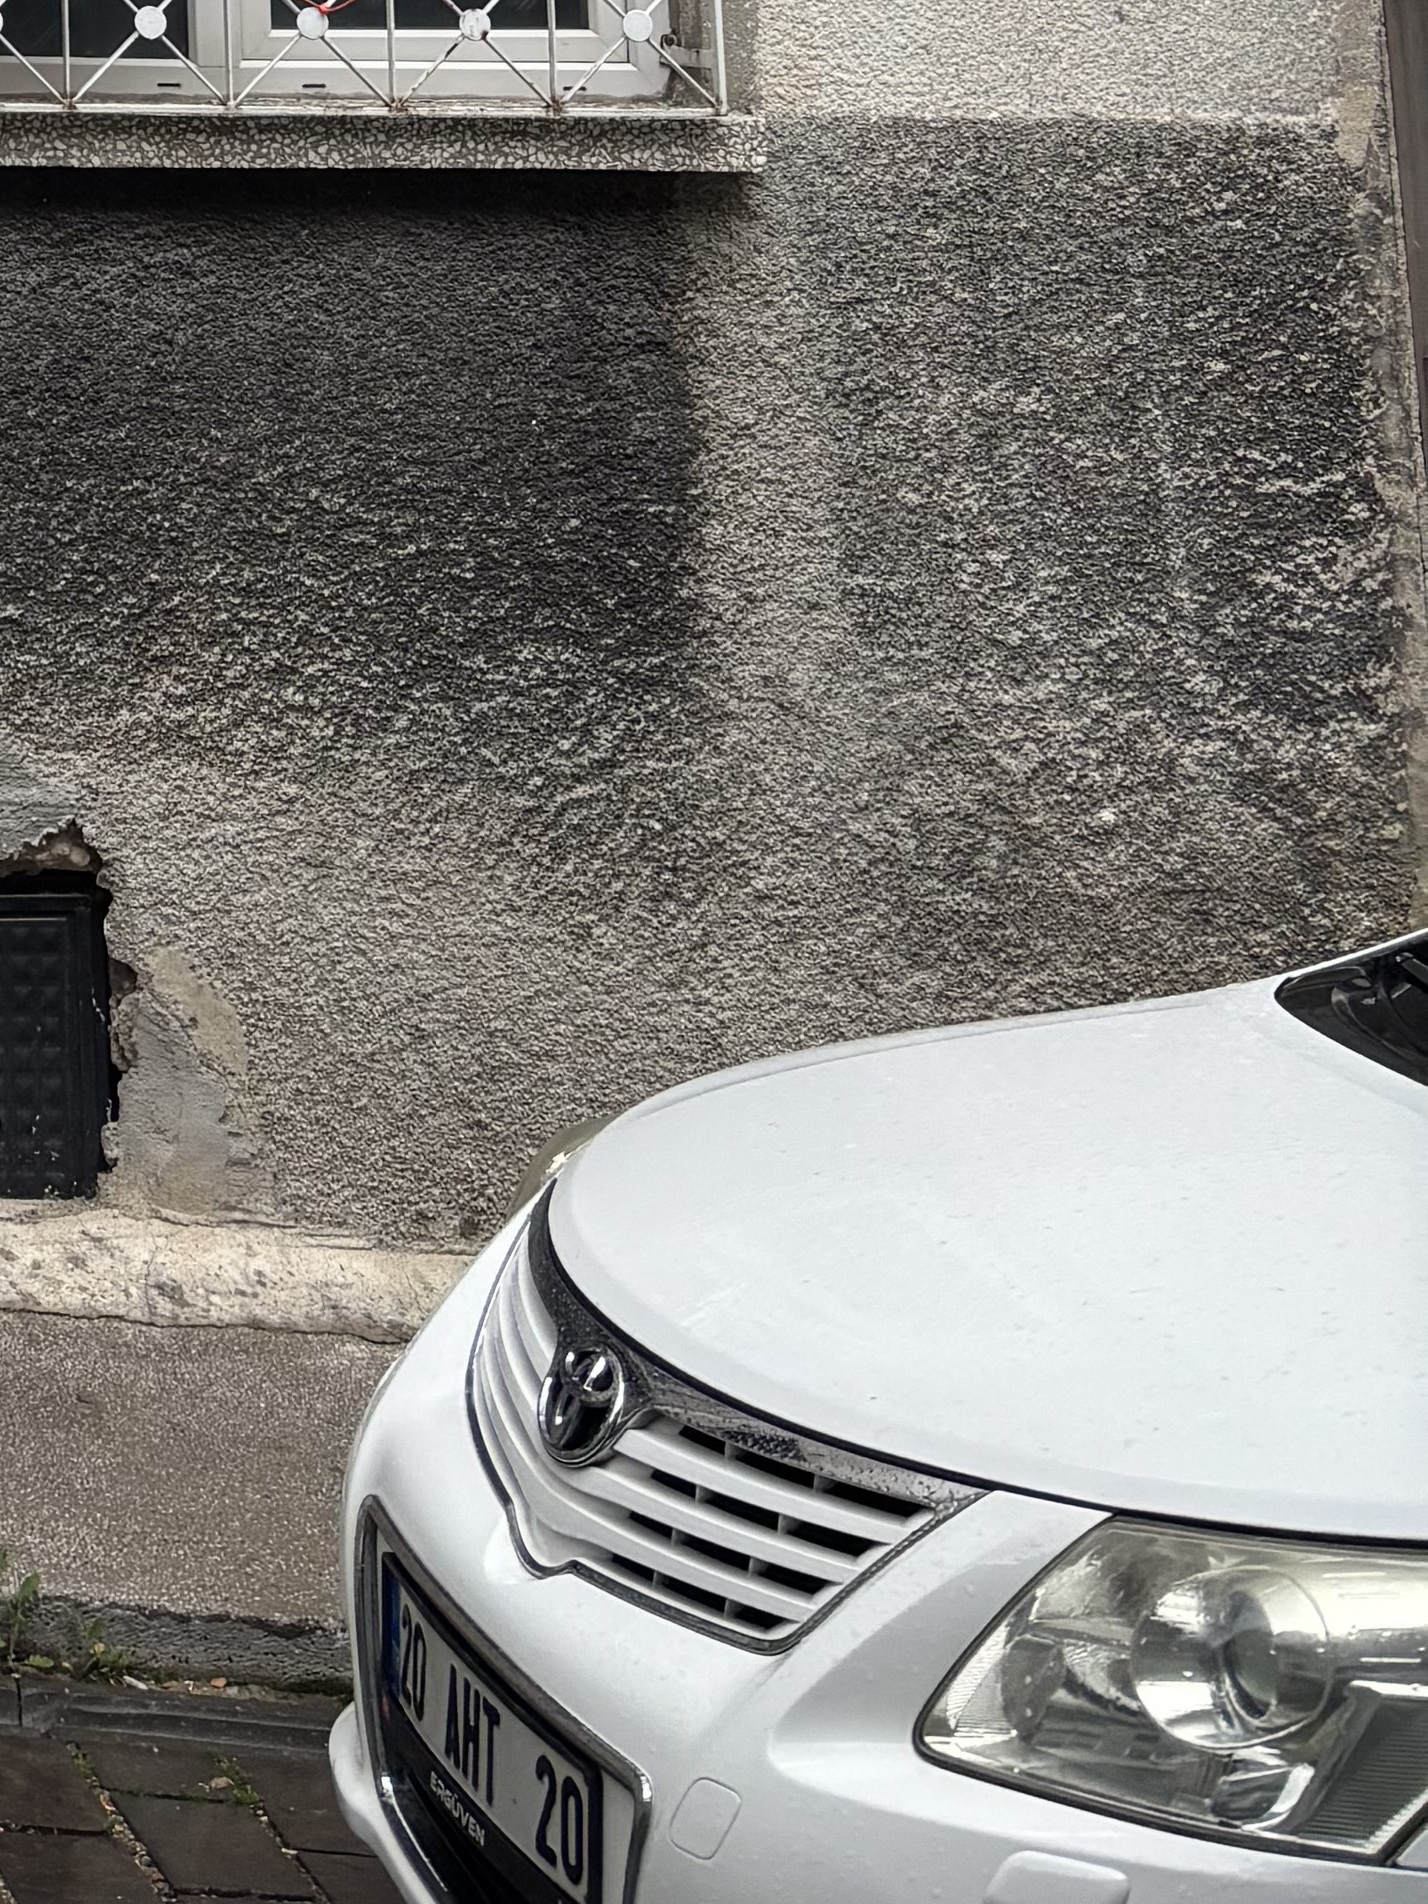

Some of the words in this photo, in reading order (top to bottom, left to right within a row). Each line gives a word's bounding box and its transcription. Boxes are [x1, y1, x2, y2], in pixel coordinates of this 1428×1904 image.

[401, 1602, 427, 1722] 20
[444, 1662, 501, 1808] AHT
[535, 1754, 584, 1886] 20
